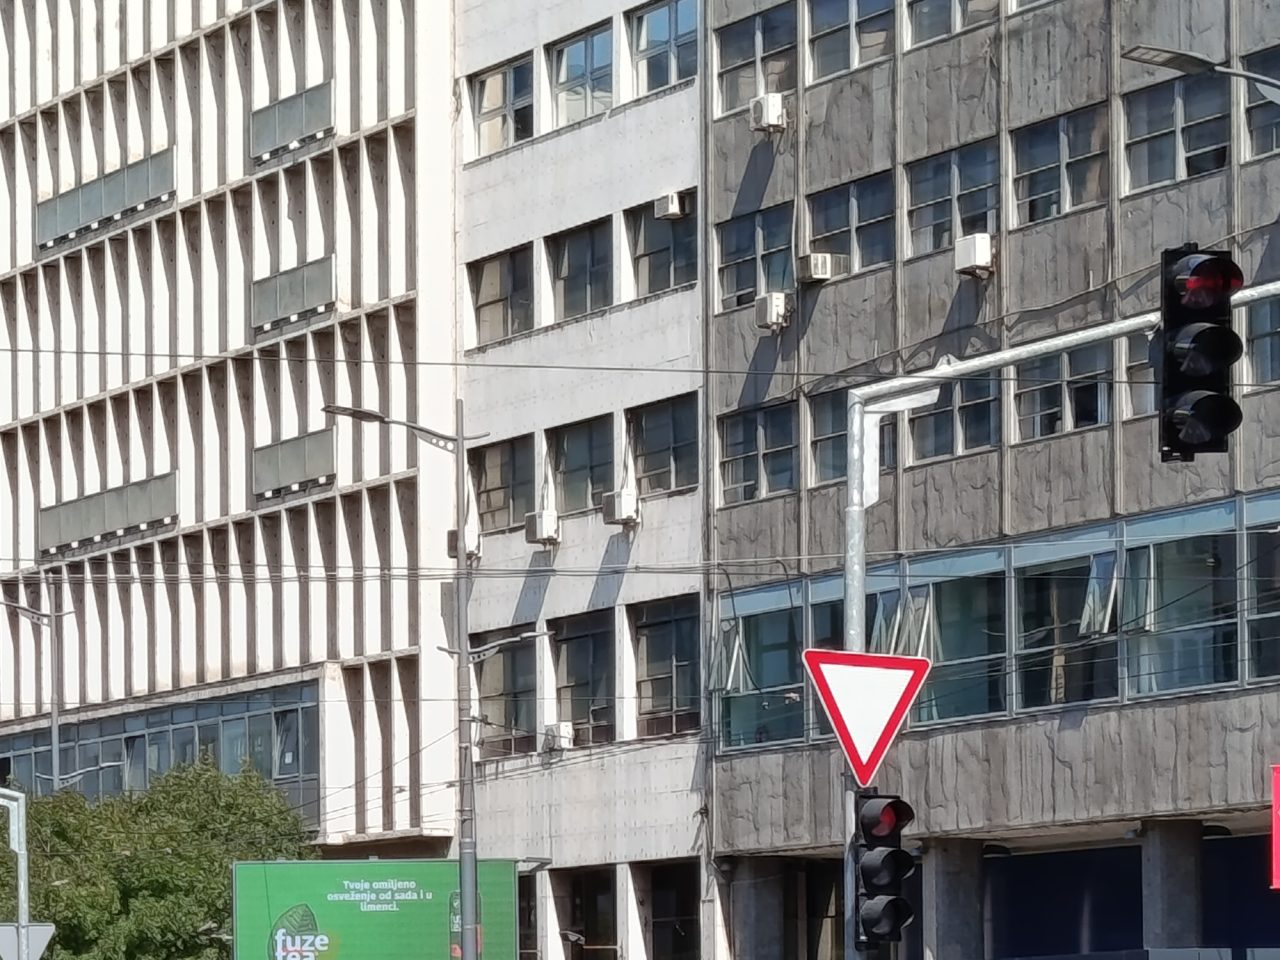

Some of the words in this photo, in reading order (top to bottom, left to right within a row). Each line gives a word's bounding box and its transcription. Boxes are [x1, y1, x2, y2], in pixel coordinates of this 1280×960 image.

[343, 880, 370, 891] Tvoje
[372, 879, 416, 891] omiljeno
[327, 890, 376, 901] osveženje
[379, 890, 391, 900] od
[394, 890, 418, 900] sada
[360, 901, 399, 912] limenci.
[274, 928, 329, 951] fuze
